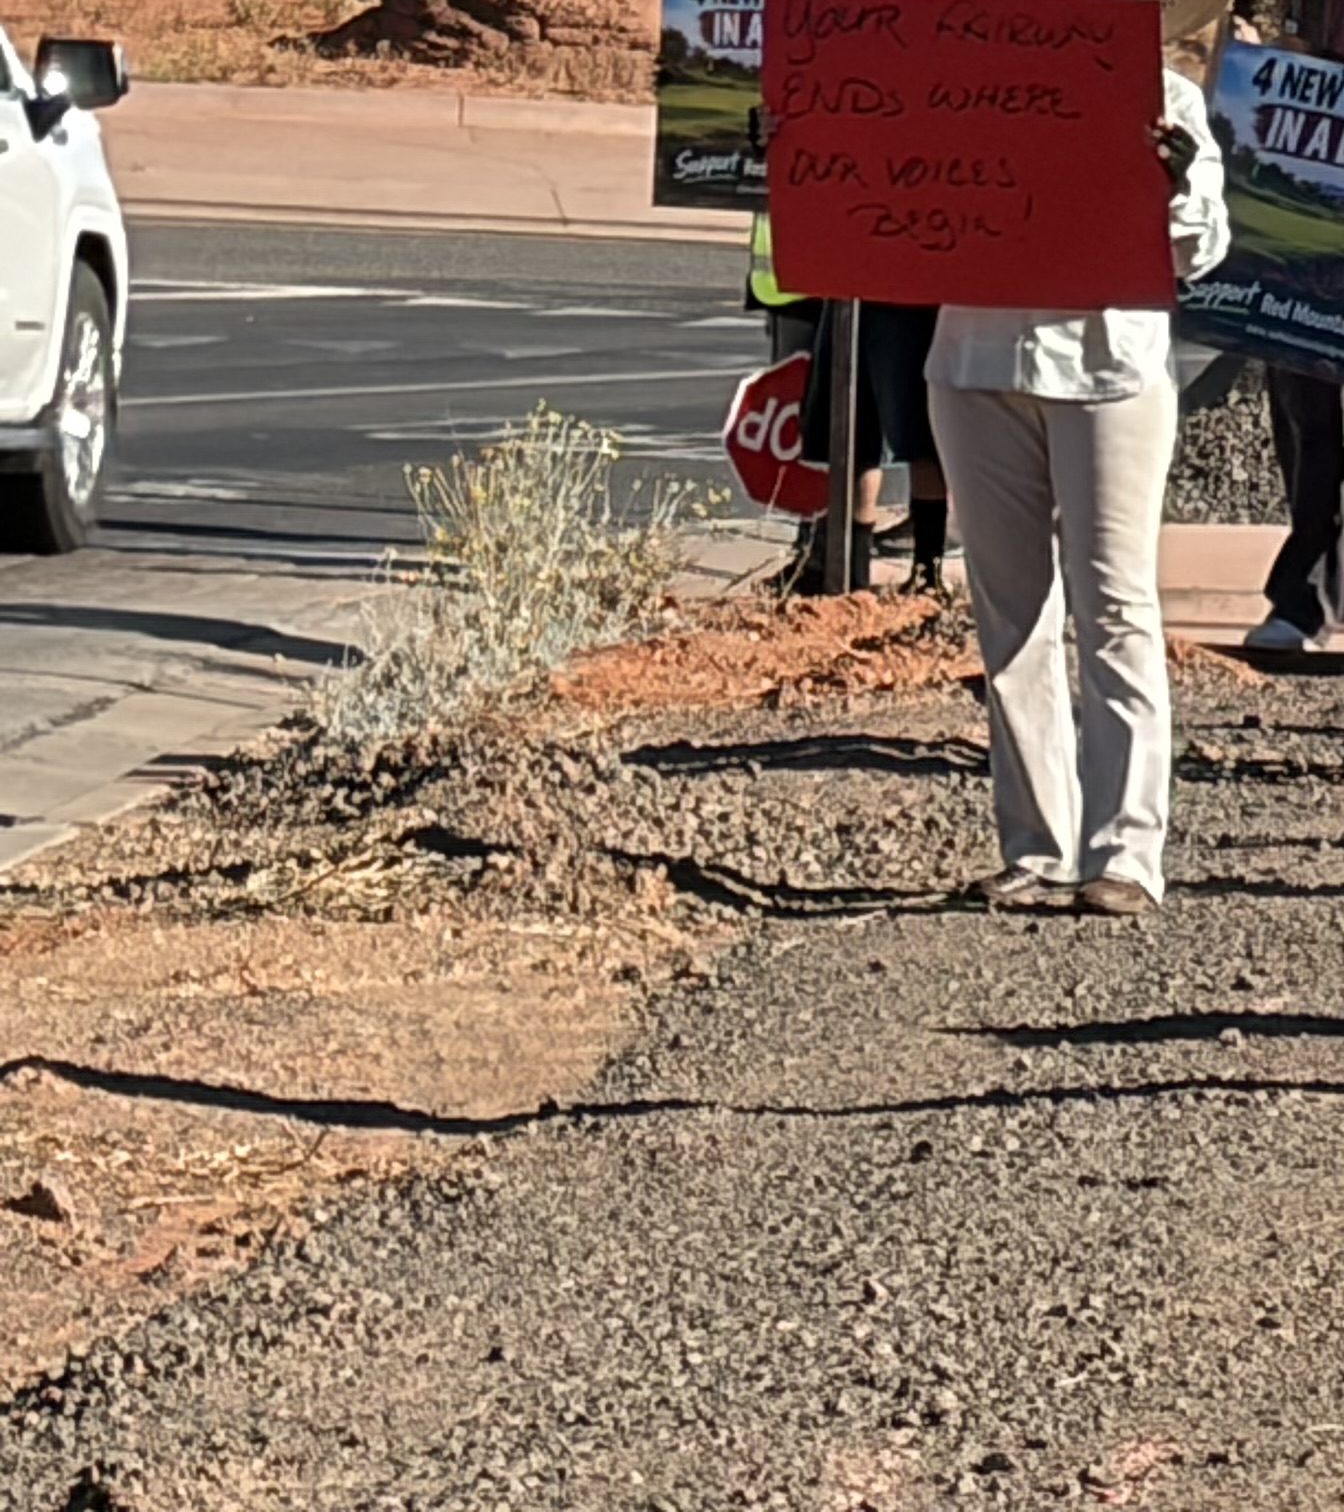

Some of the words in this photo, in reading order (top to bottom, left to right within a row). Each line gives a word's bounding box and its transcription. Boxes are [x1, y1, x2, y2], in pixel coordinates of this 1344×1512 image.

[713, 11, 740, 47] IN
[746, 12, 762, 48] A
[781, 73, 905, 118] ENDS
[928, 83, 1083, 120] WHERE
[1252, 57, 1277, 97] 4
[1264, 107, 1306, 154] IN
[1304, 118, 1332, 160] A
[672, 149, 740, 179] Support
[788, 147, 868, 189] OUR
[886, 156, 1017, 189] VOICES
[1177, 280, 1262, 309] Support
[1260, 292, 1293, 321] Red
[737, 396, 802, 463] OP
